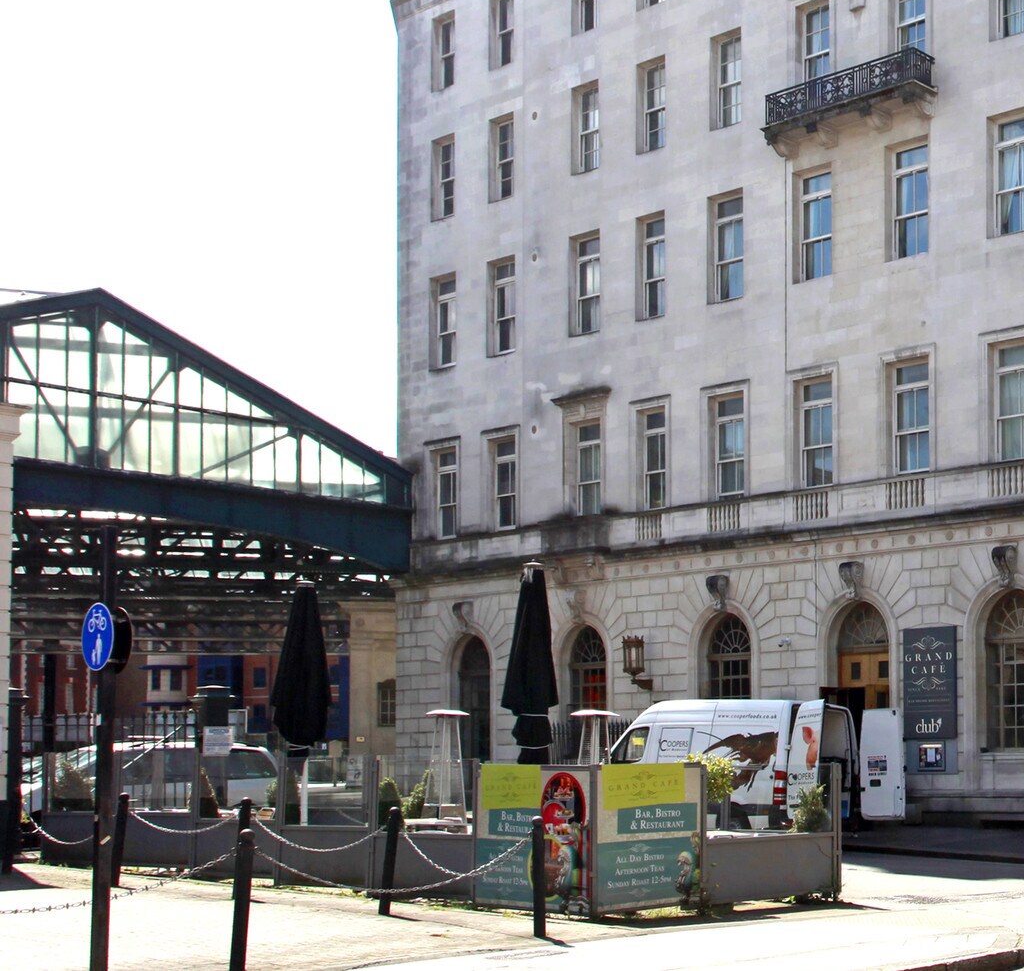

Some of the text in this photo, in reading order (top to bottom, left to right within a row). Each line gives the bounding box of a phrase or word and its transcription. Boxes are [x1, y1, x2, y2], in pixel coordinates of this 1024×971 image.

[905, 651, 953, 662] GRAND
[911, 662, 946, 674] CAFÉ
[659, 739, 689, 751] COOPERS
[788, 773, 814, 785] COPERS
[608, 782, 646, 791] GRAND
[516, 811, 533, 822] BISTR
[635, 808, 681, 819] BAR, BISTRO
[497, 822, 503, 831] &
[630, 820, 685, 830] & RESTAURANT
[615, 856, 628, 864] ALL
[644, 853, 664, 861] BISTRO
[615, 864, 665, 876] AFTERNOON TEAS
[607, 880, 630, 889] SUNDAY
[631, 878, 650, 886] ROAST
